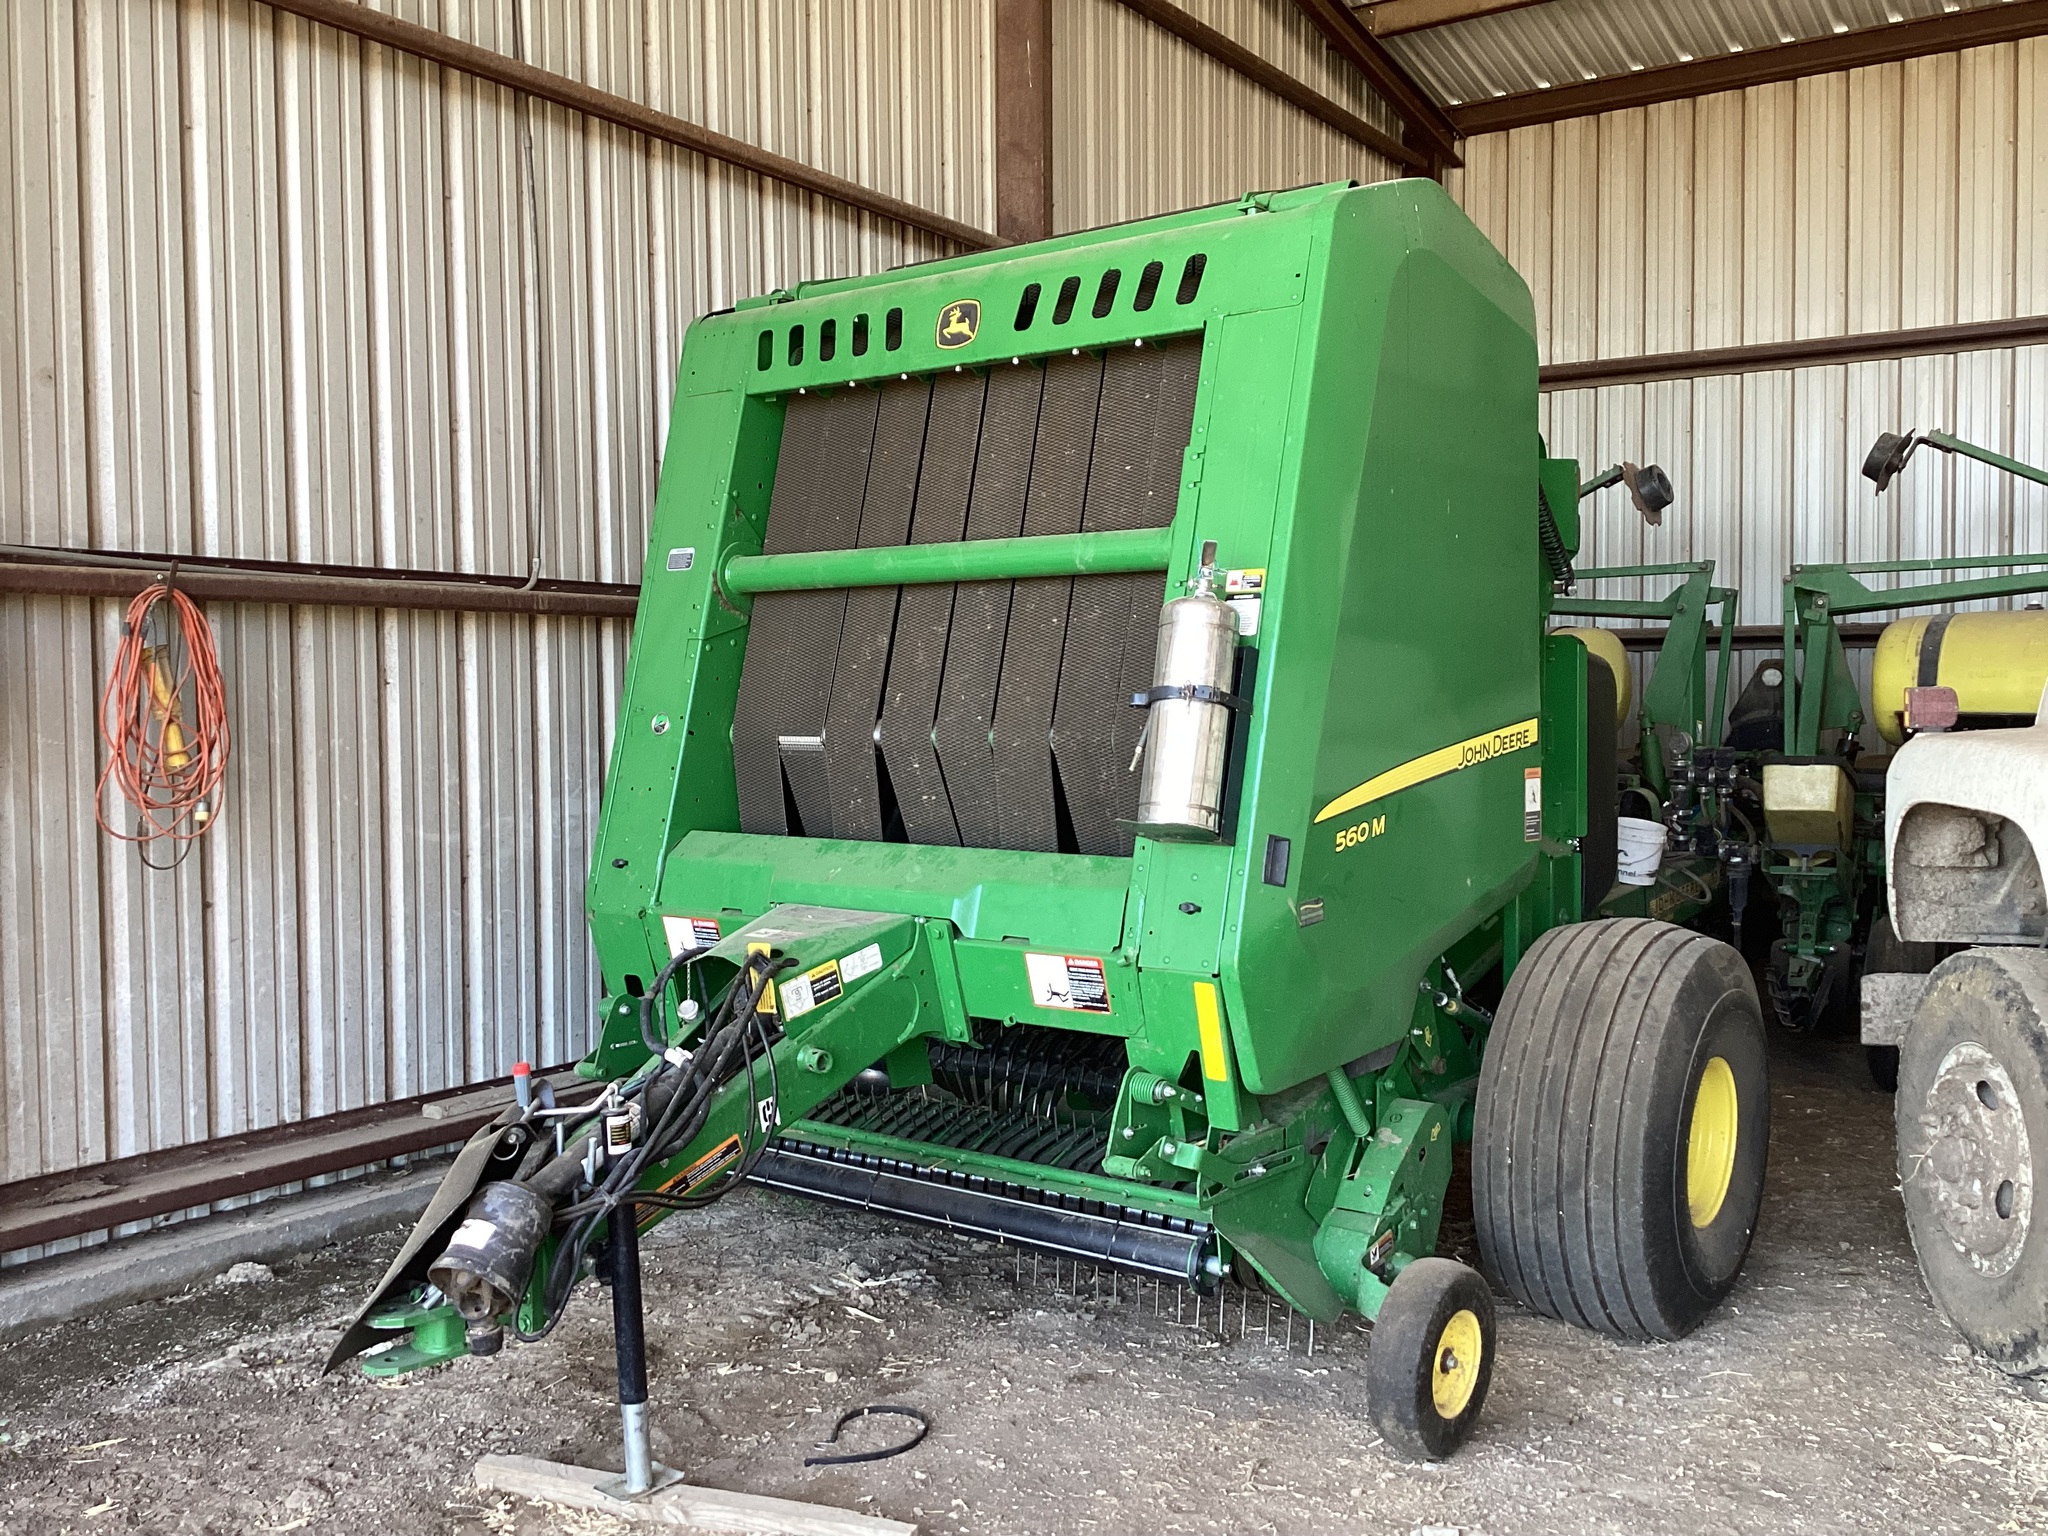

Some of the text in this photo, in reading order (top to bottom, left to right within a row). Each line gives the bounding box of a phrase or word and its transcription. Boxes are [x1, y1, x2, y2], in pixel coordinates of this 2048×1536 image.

[1458, 729, 1530, 767] JOHN DEERE
[1335, 814, 1386, 853] 560 M
